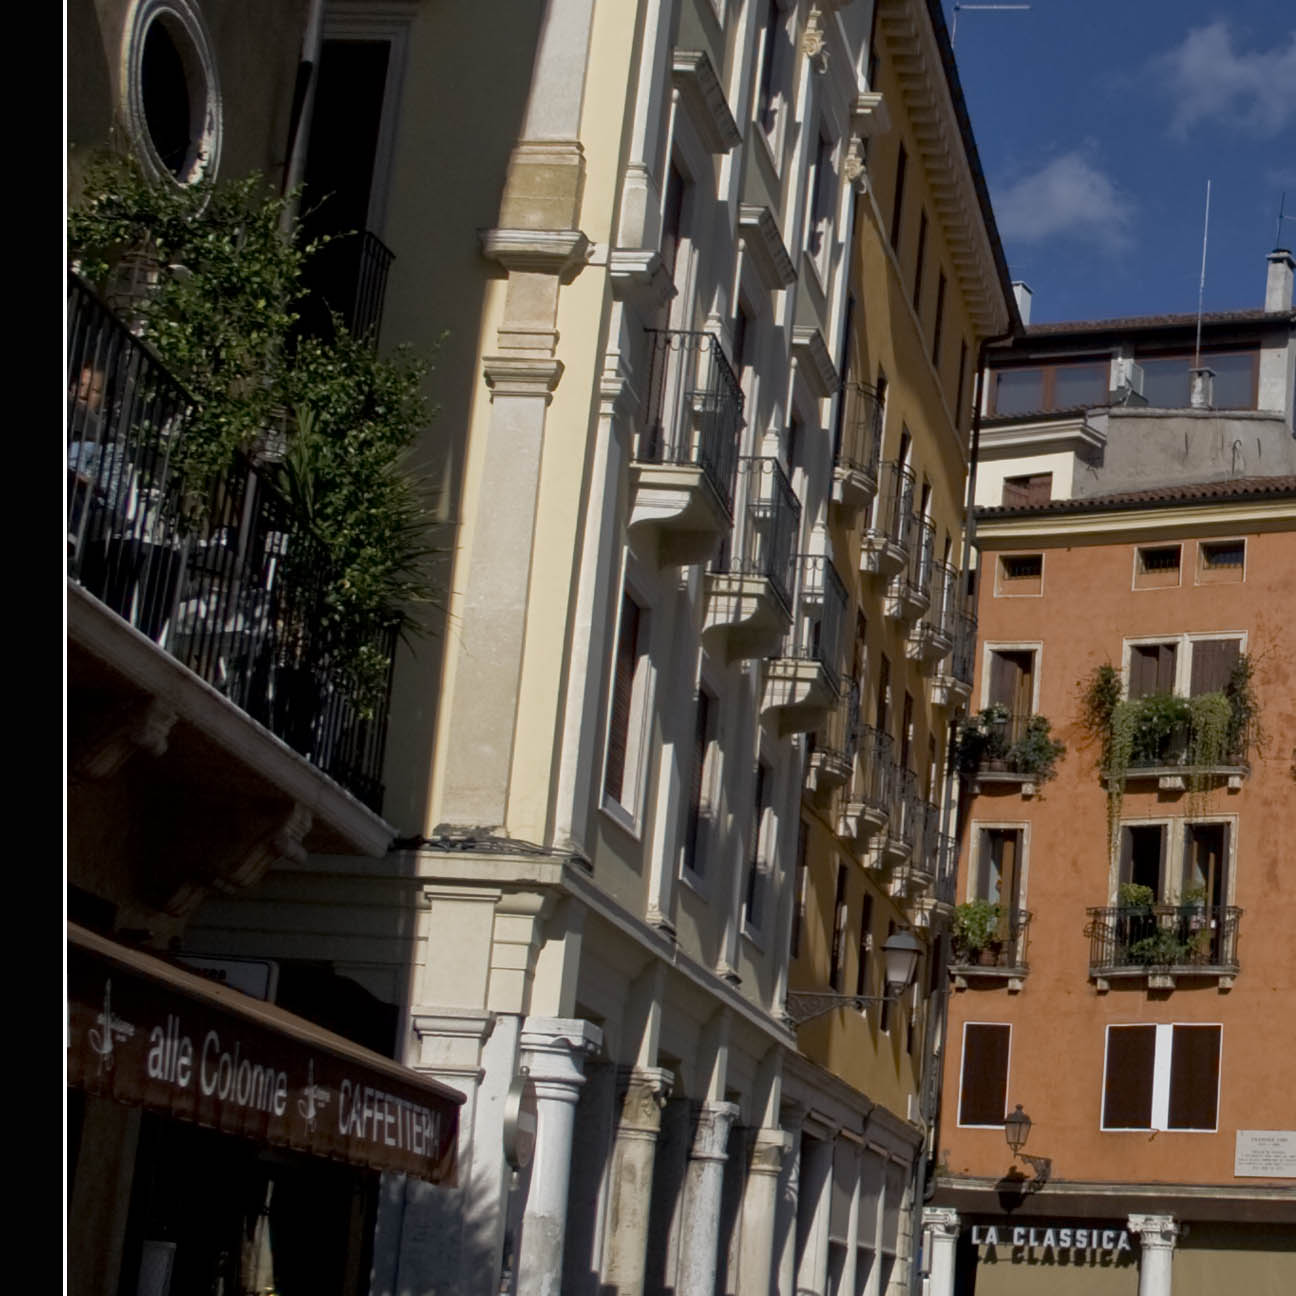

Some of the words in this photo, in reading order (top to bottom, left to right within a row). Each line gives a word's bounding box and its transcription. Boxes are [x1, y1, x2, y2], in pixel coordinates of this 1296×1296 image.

[147, 1014, 193, 1087] alle
[200, 1031, 288, 1116] Colonne
[339, 1078, 441, 1160] CAFFETTERIA
[972, 1225, 998, 1245] LA
[1013, 1226, 1131, 1251] CLASSICA
